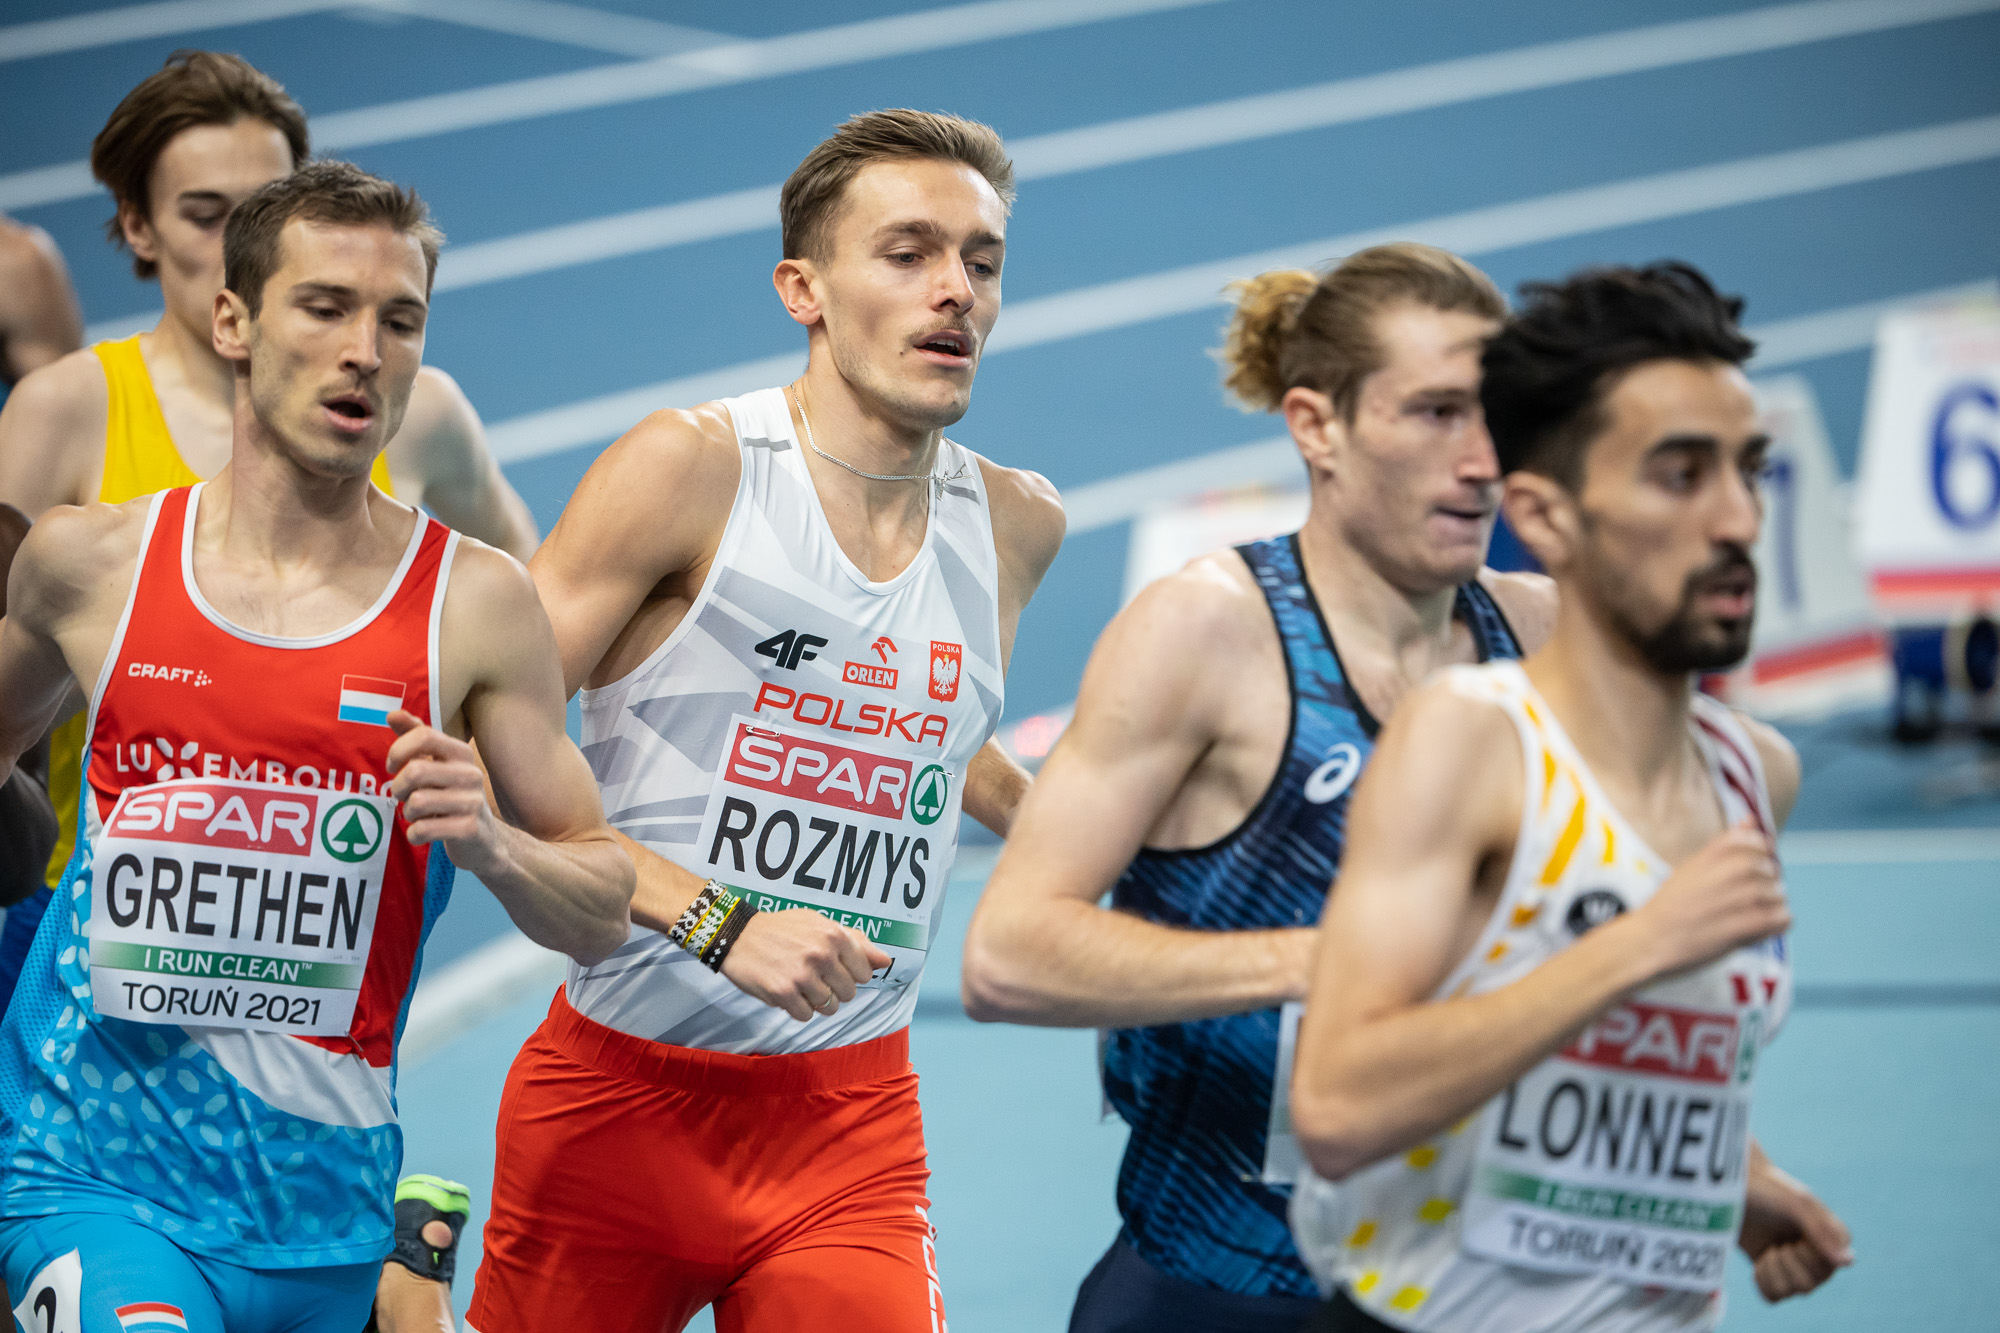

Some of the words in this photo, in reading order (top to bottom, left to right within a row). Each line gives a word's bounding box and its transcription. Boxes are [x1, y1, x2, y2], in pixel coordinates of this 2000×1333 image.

[1931, 382, 2000, 530] 6
[128, 662, 194, 683] CRAFT
[754, 629, 829, 671] 4F
[846, 665, 895, 687] ORLEN
[932, 643, 960, 654] POLSKA
[753, 681, 949, 747] POLSKA
[734, 736, 906, 811] SPAR
[116, 791, 309, 847] SPAR
[708, 796, 931, 909] ROZMYS
[106, 853, 368, 950] GRETHEN
[144, 949, 151, 968] I
[158, 950, 213, 974] RUN
[122, 982, 239, 1017] TORUŃ
[245, 993, 321, 1025] 2021
[1578, 1008, 1732, 1075] PAR
